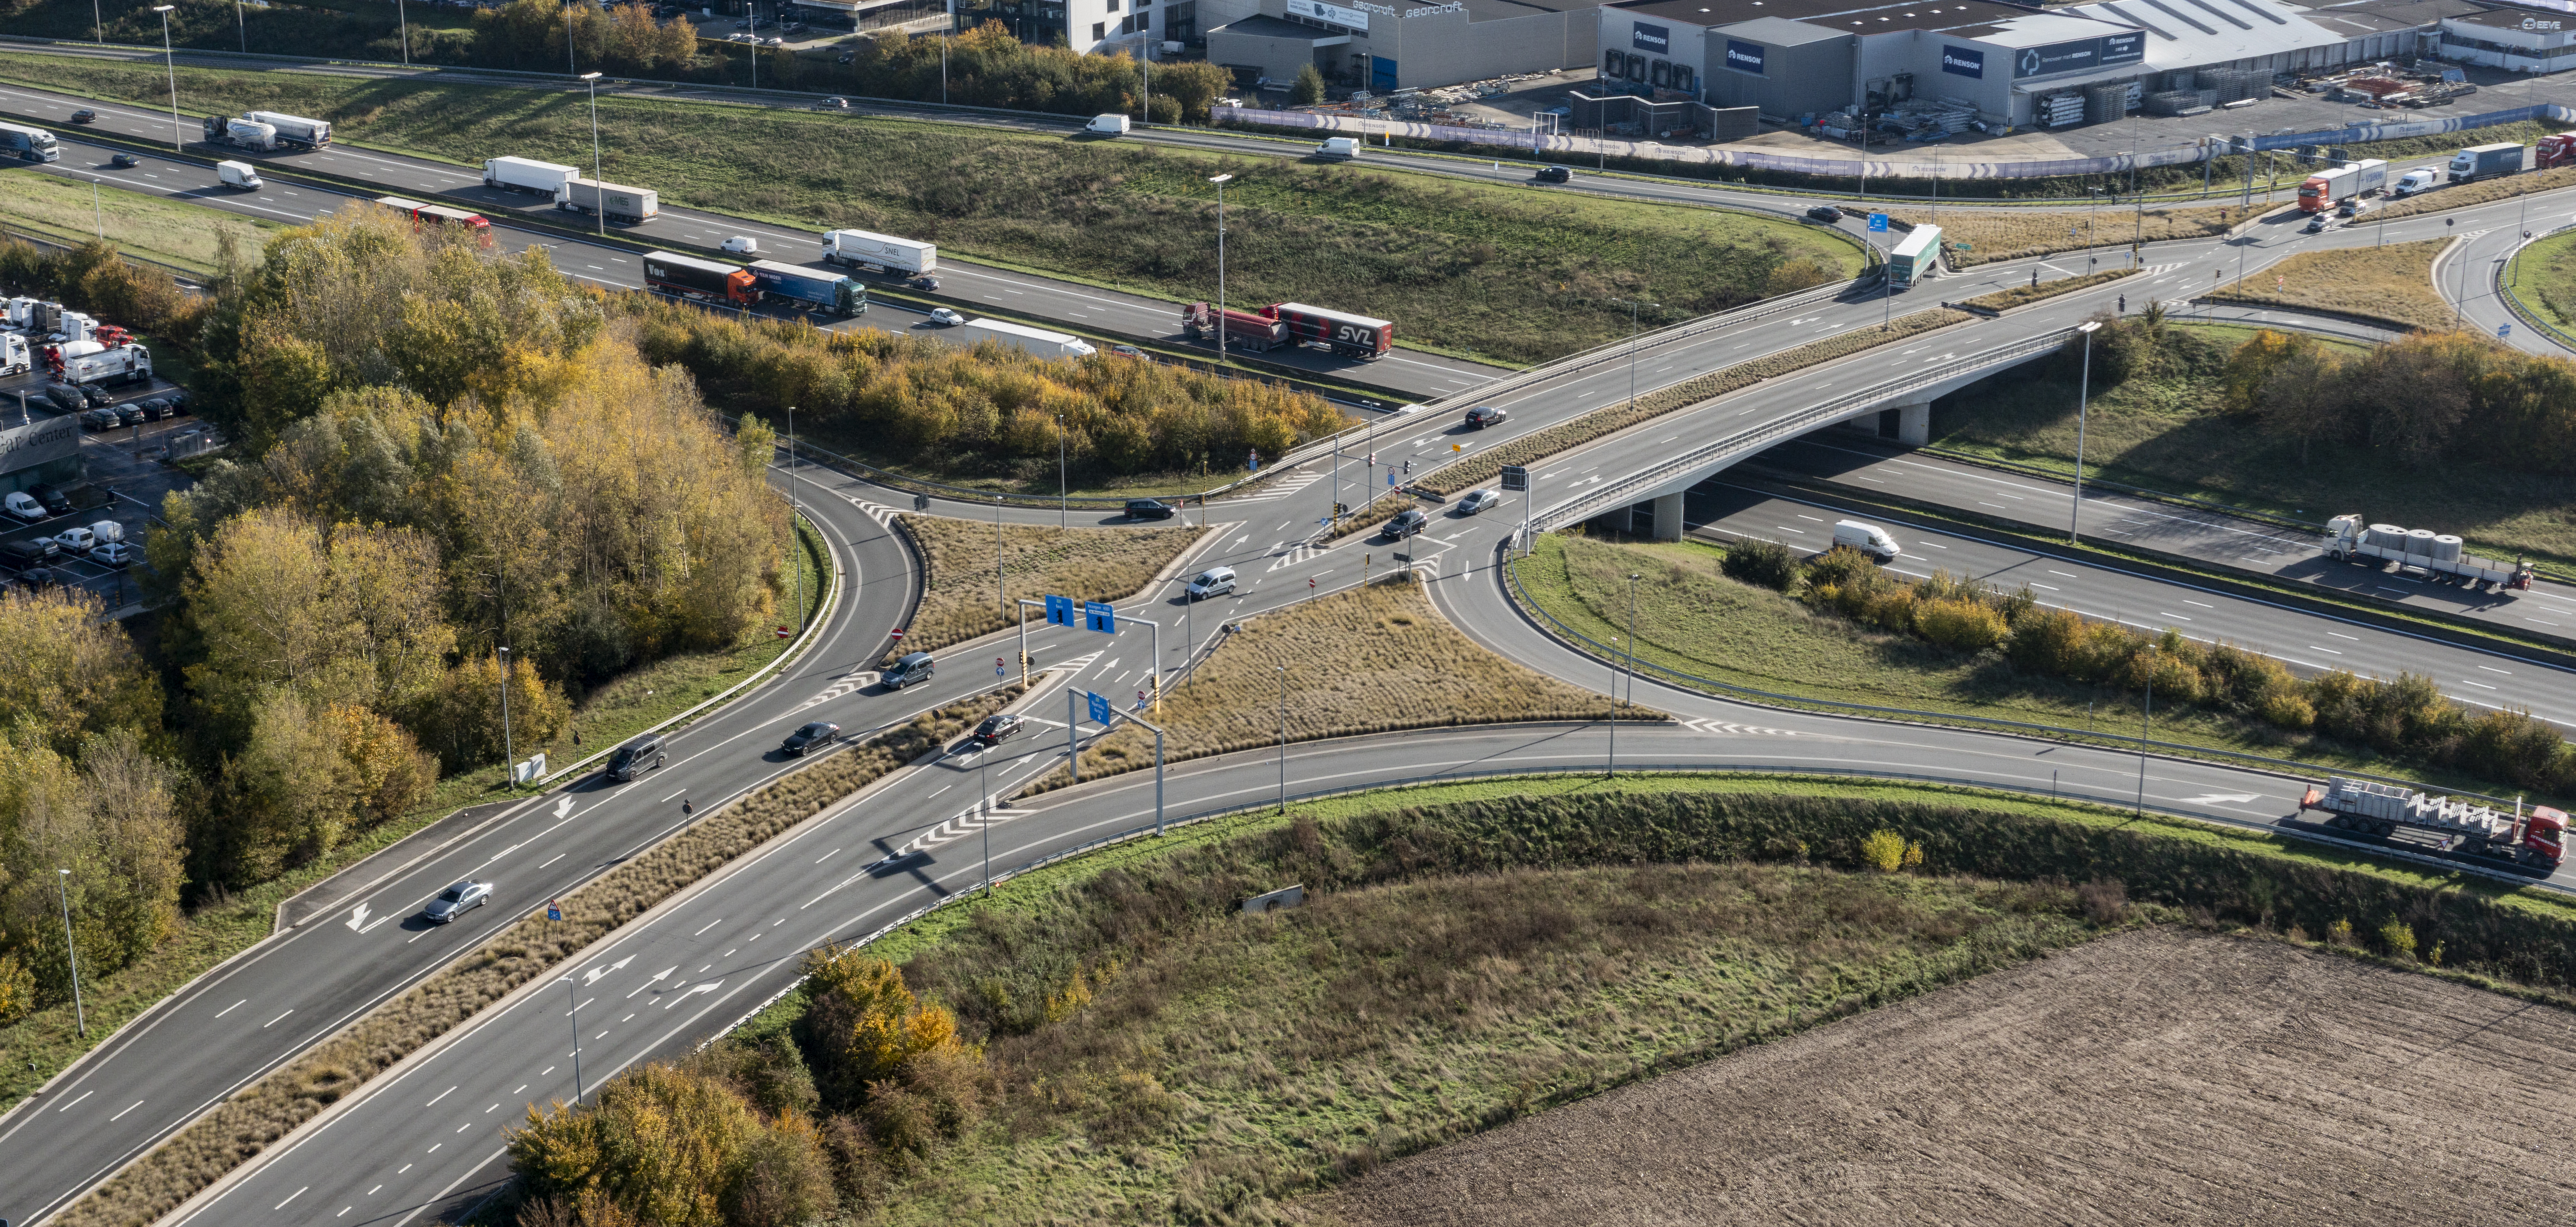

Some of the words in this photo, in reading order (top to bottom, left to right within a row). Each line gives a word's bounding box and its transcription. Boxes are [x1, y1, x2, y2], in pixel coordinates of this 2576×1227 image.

[2537, 21, 2561, 30] EEVE
[1643, 34, 1666, 45] RENSON
[1737, 54, 1761, 64] RENSON
[1954, 59, 1979, 69] RENSON
[885, 247, 900, 256] SNEL
[648, 264, 665, 277] Vos
[1338, 325, 1374, 346] SVZ
[29, 426, 72, 447] Center
